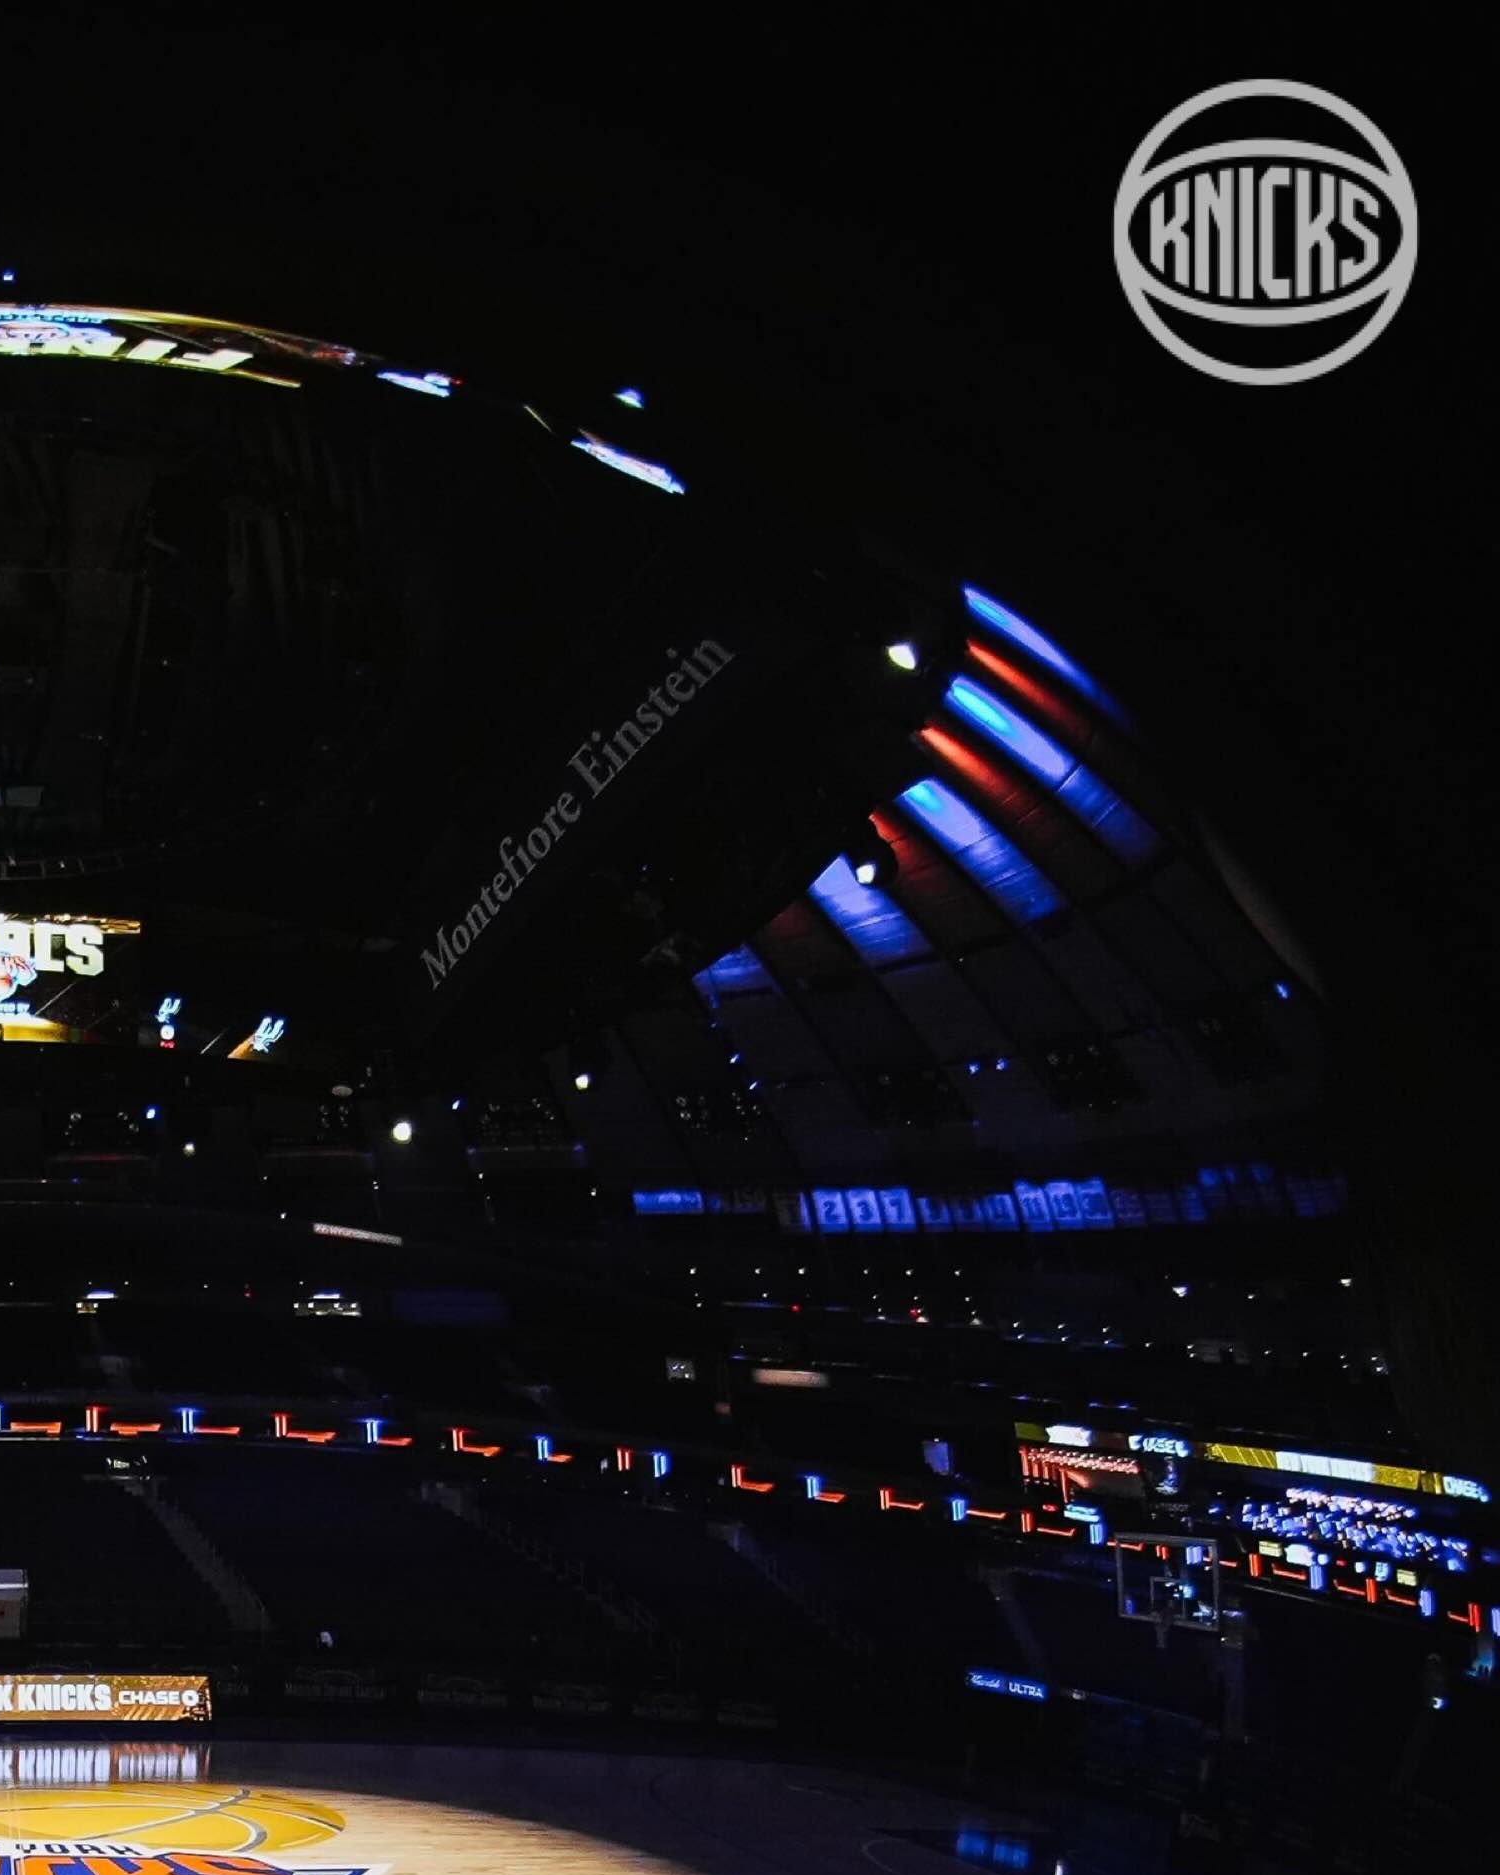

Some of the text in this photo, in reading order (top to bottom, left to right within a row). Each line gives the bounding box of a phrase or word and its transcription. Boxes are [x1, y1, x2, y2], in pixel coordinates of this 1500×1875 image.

[419, 639, 736, 991] Montefiore Einstein
[823, 1199, 839, 1222] 2
[857, 1199, 873, 1221] 3
[18, 1684, 112, 1712] KNICKS
[118, 1689, 180, 1705] CHASE
[1008, 1681, 1044, 1698] ULTRA
[15, 1843, 143, 1856] YORK
